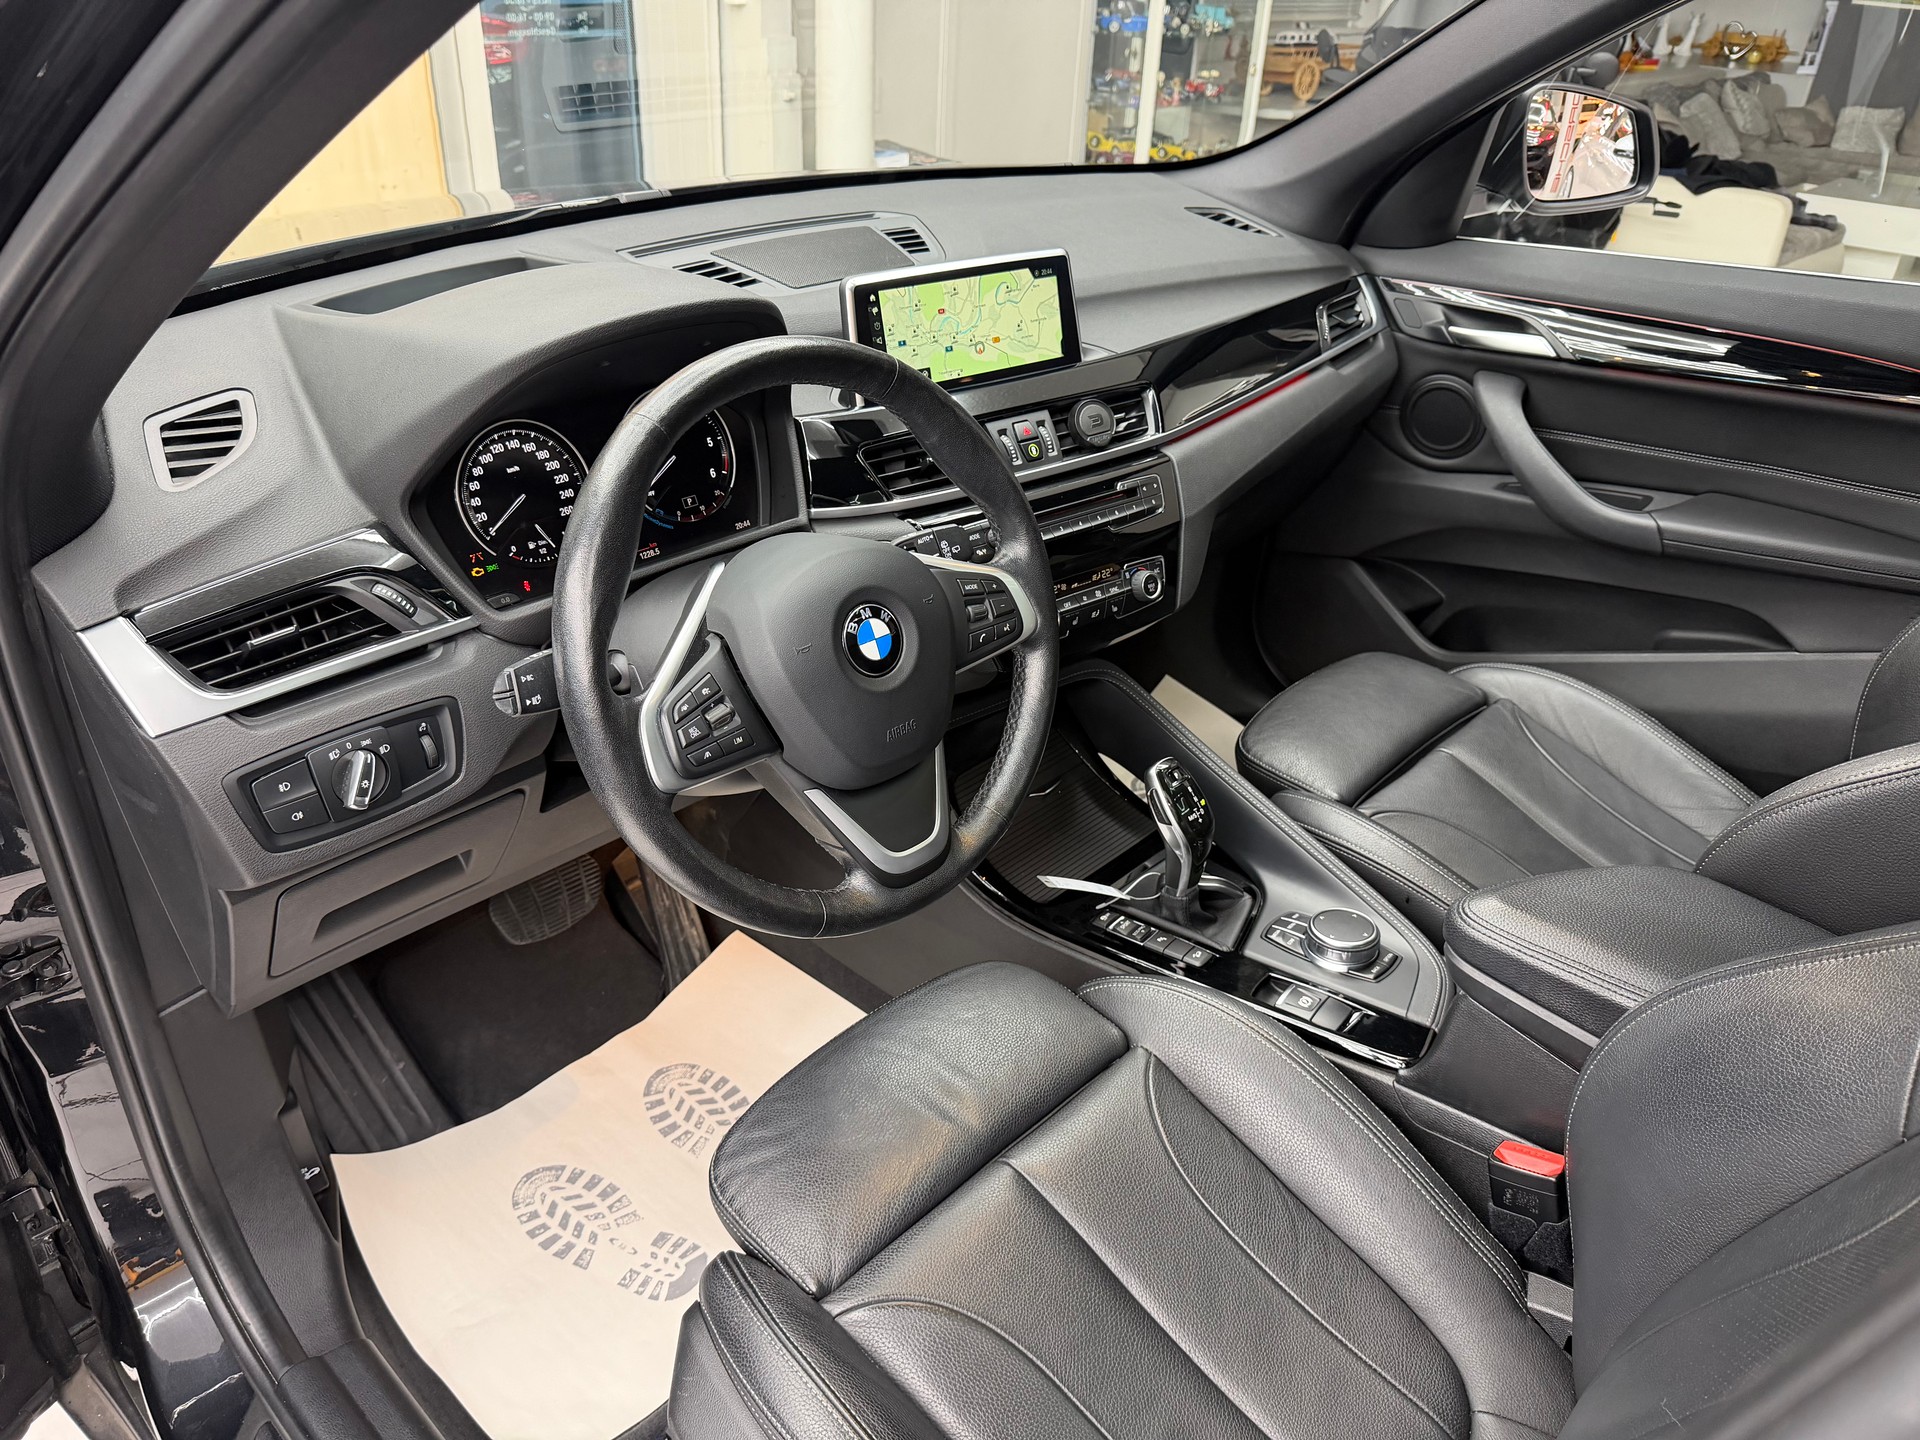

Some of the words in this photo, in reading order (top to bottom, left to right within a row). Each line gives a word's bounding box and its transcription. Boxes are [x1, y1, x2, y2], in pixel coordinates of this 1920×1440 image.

[505, 438, 521, 451] 140
[521, 442, 537, 453] 160
[706, 436, 714, 448] 5
[489, 442, 505, 455] 120
[478, 452, 494, 465] 100
[535, 449, 550, 461] 180
[472, 465, 484, 477] 80
[544, 460, 561, 472] 200
[553, 473, 570, 485] 220
[709, 467, 717, 479] 6
[468, 480, 481, 492] 60
[558, 488, 575, 500] 240
[470, 496, 482, 507] 40
[475, 511, 488, 523] 20
[734, 519, 751, 530] 20:44
[917, 535, 930, 545] AUTO
[510, 545, 517, 553] 0
[639, 547, 661, 560] 1228.5
[500, 596, 511, 604] 0.0
[847, 607, 892, 635] BMW
[886, 718, 917, 742] AIRBAG
